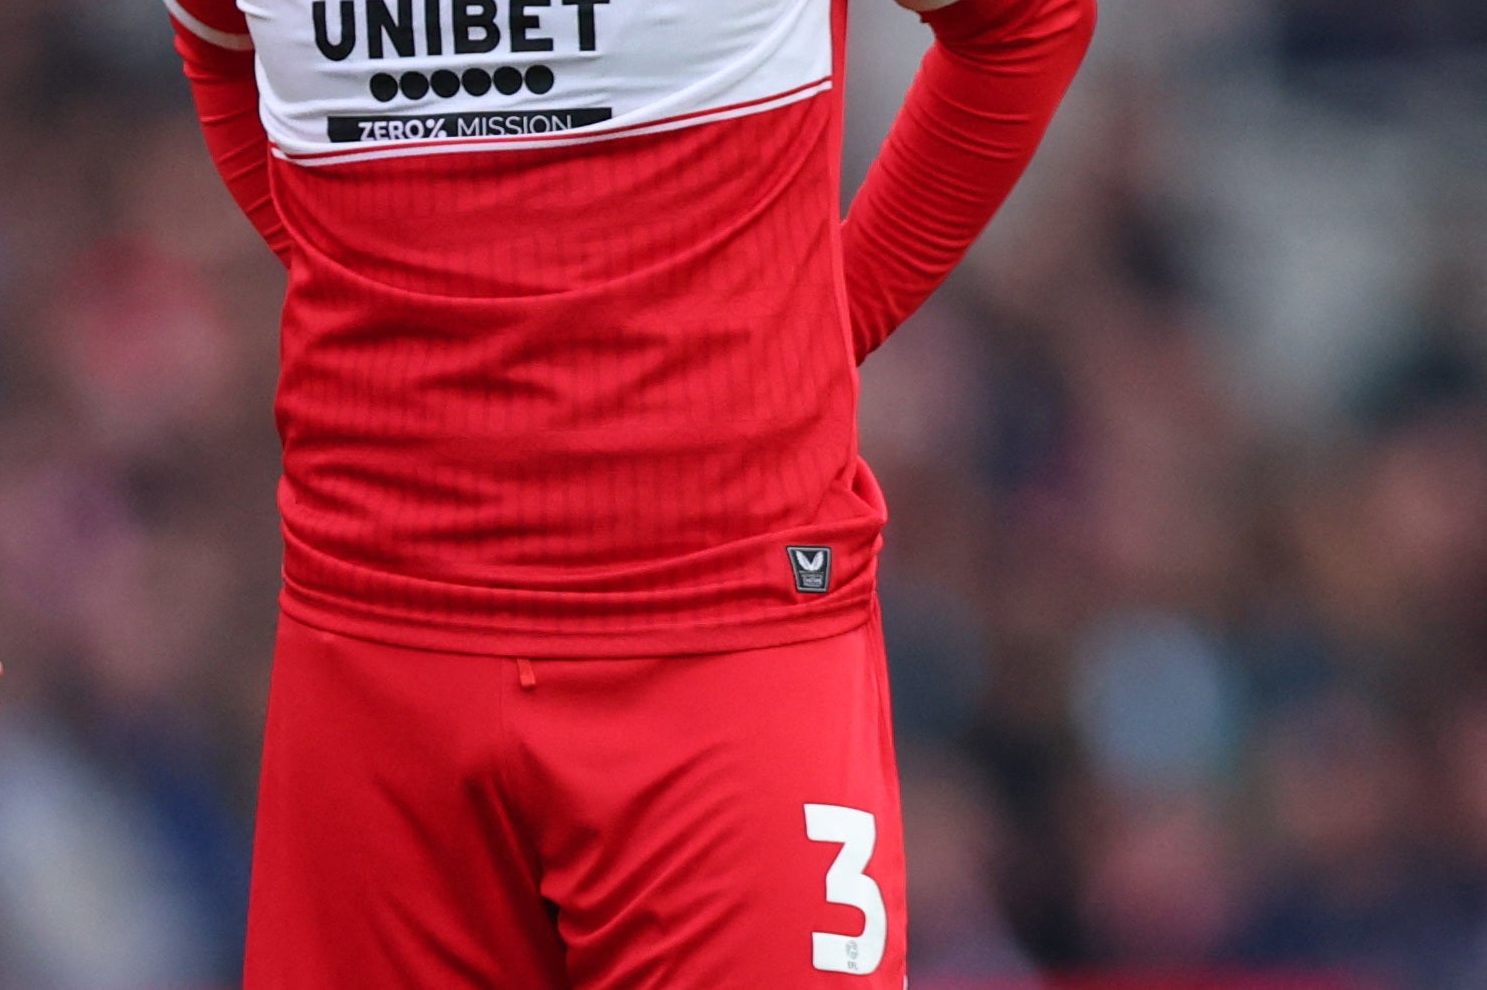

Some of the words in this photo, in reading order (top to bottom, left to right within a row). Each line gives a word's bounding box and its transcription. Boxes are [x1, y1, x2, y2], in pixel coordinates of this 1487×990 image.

[358, 117, 448, 142] ZERO%
[457, 114, 573, 138] MISSION
[803, 803, 888, 976] 3
